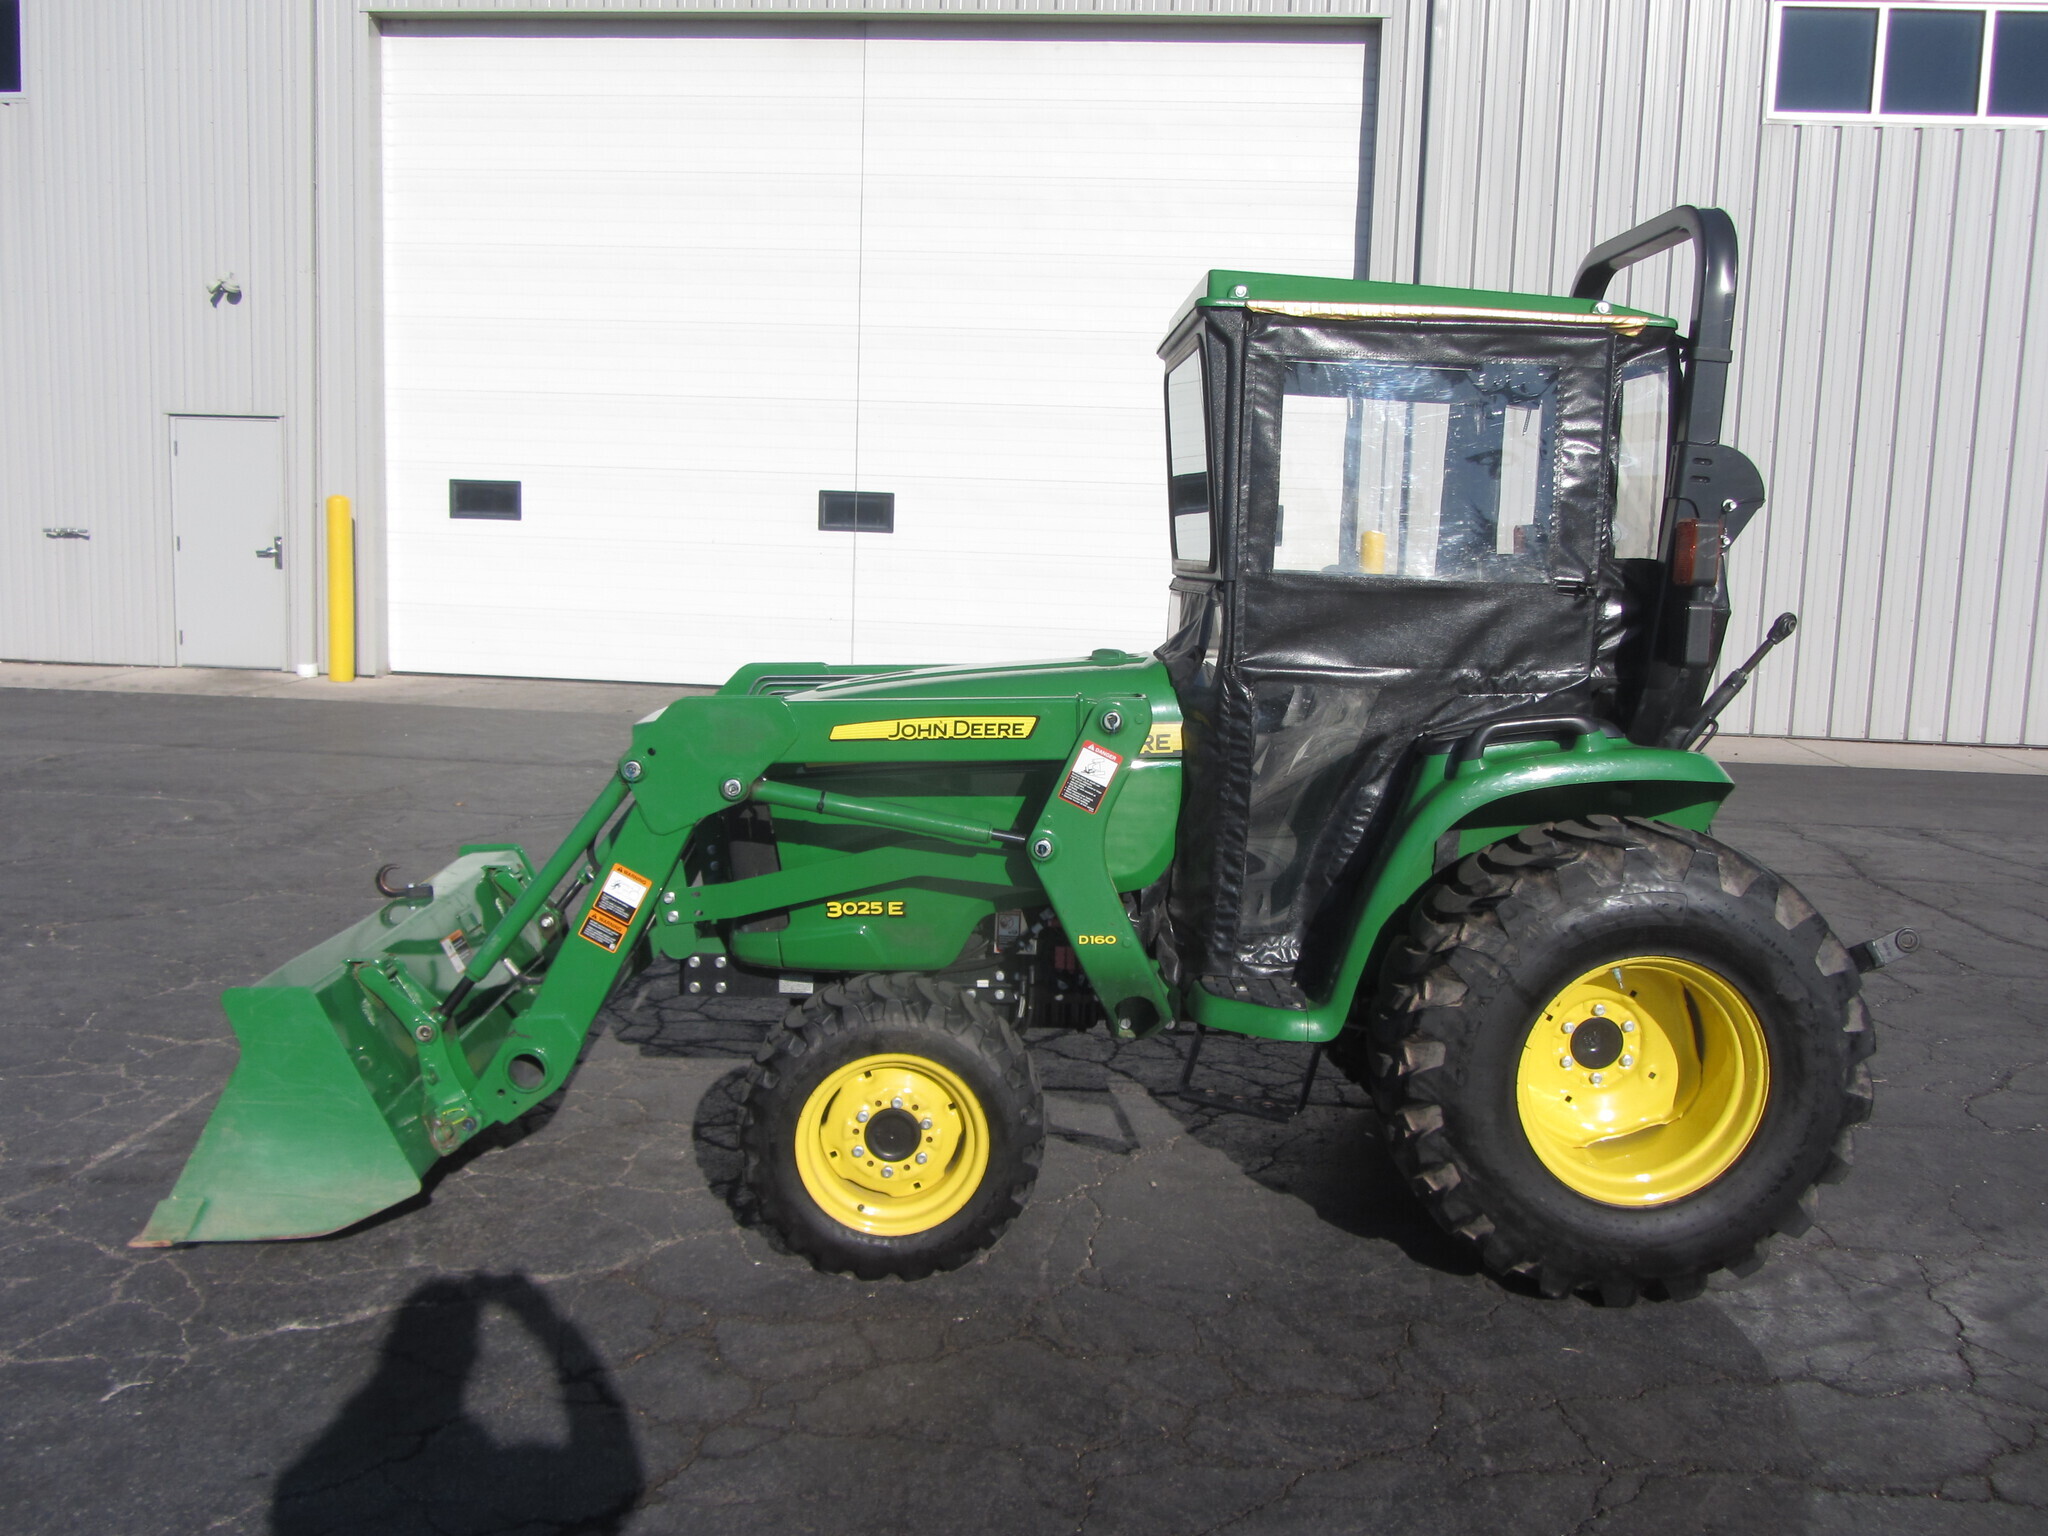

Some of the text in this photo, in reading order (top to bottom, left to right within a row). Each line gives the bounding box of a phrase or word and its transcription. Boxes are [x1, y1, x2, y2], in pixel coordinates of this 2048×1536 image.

[889, 720, 1025, 738] JOHN DEERE
[1095, 747, 1117, 761] DANGER
[623, 867, 647, 885] WARNING
[826, 901, 905, 918] 3025 E
[599, 916, 622, 932] WARNING
[1078, 935, 1117, 945] D160
